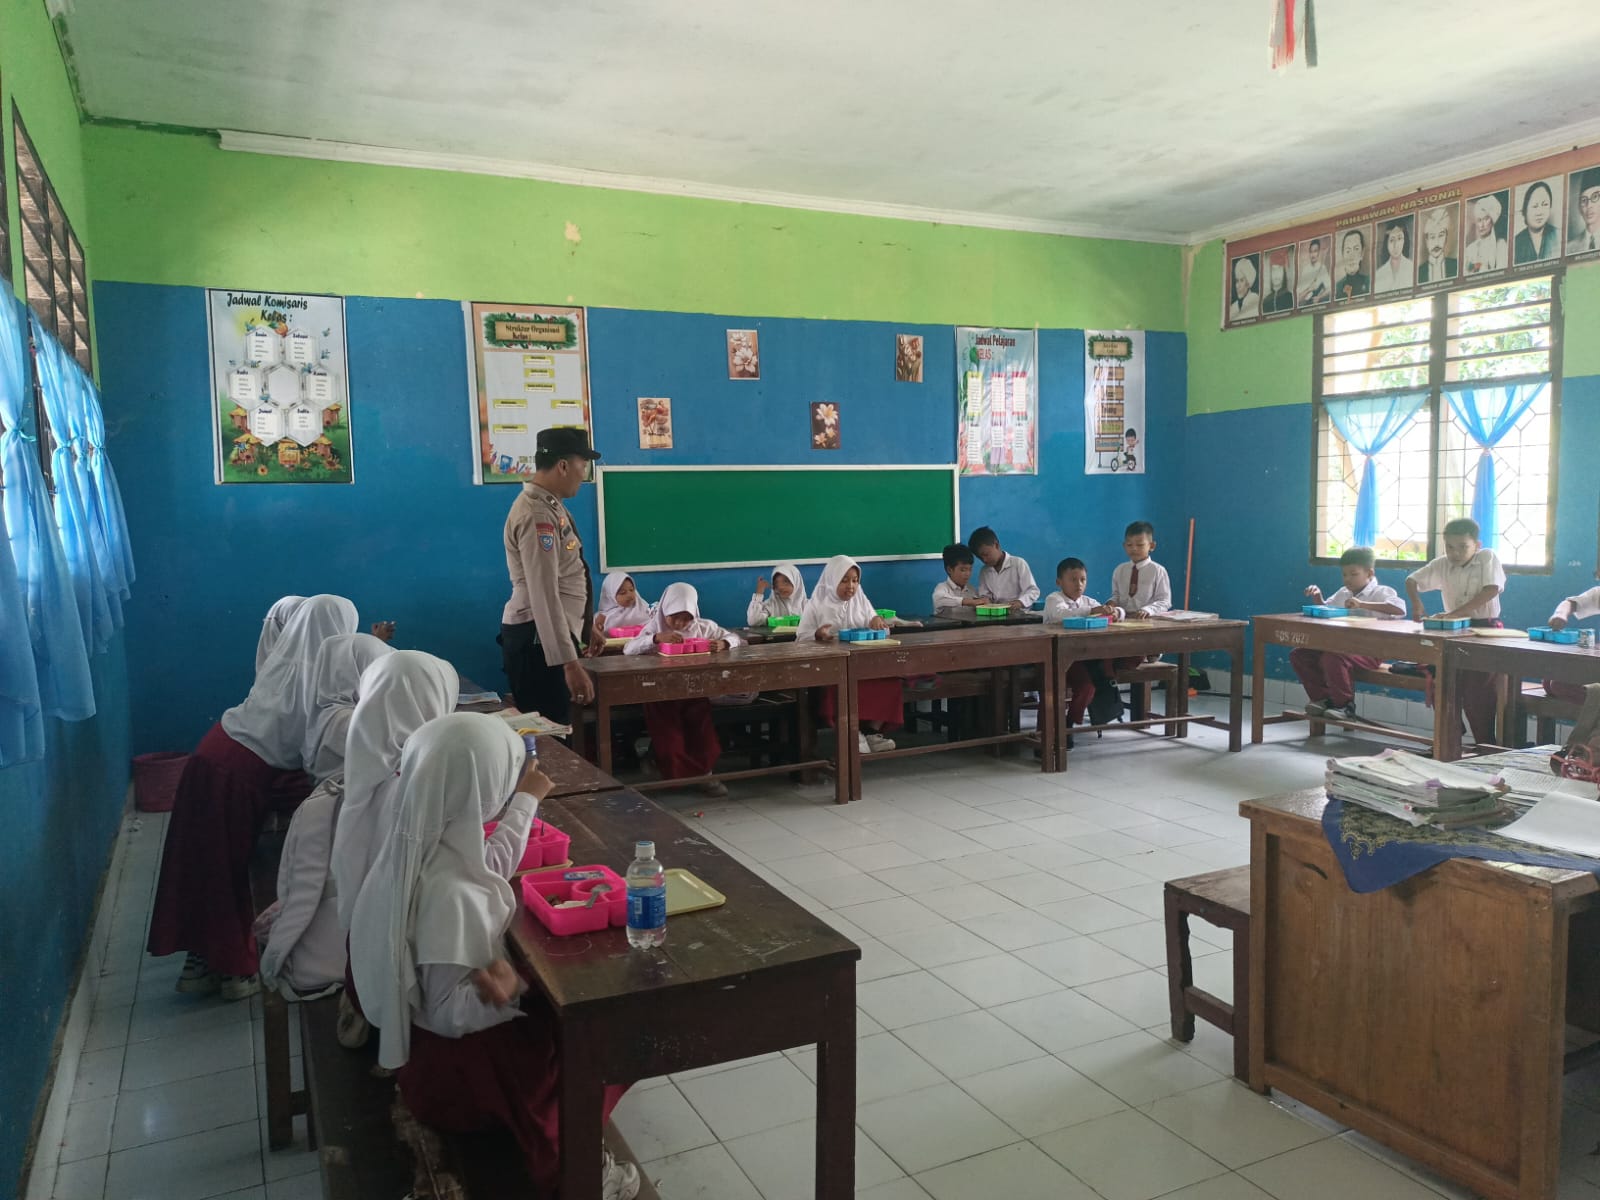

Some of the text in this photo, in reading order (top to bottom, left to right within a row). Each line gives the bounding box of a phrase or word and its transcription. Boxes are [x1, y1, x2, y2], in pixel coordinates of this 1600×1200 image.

[1400, 188, 1463, 211] NASIONAL
[227, 292, 308, 310] Jadwal Komisaris
